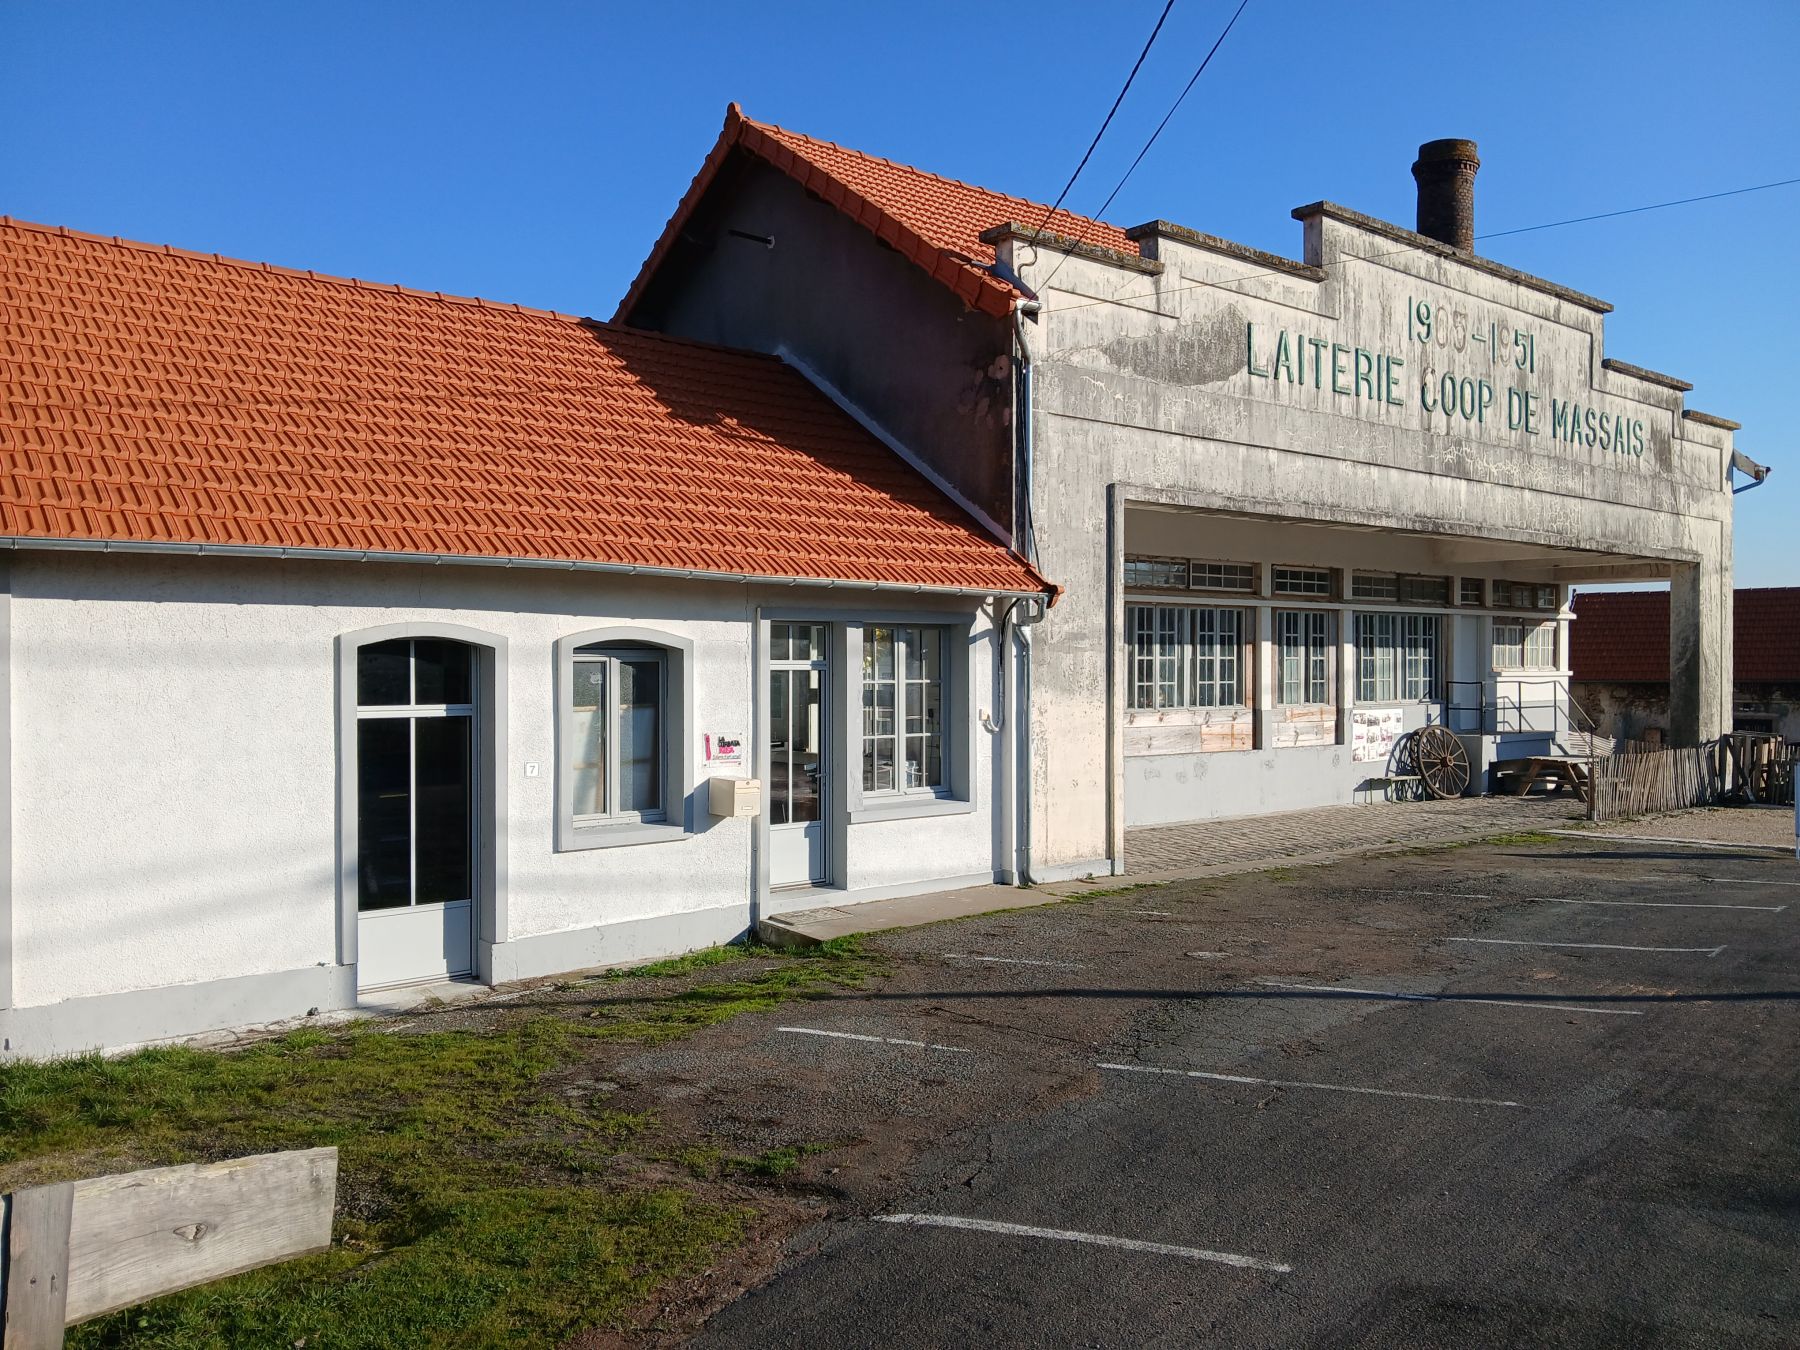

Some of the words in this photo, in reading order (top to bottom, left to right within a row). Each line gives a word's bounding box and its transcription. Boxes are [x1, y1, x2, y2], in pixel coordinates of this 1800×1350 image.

[1246, 321, 1404, 406] LAITERIE
[1422, 367, 1493, 423] COOP
[1508, 386, 1540, 435] DE
[1552, 399, 1645, 457] MASSAIS
